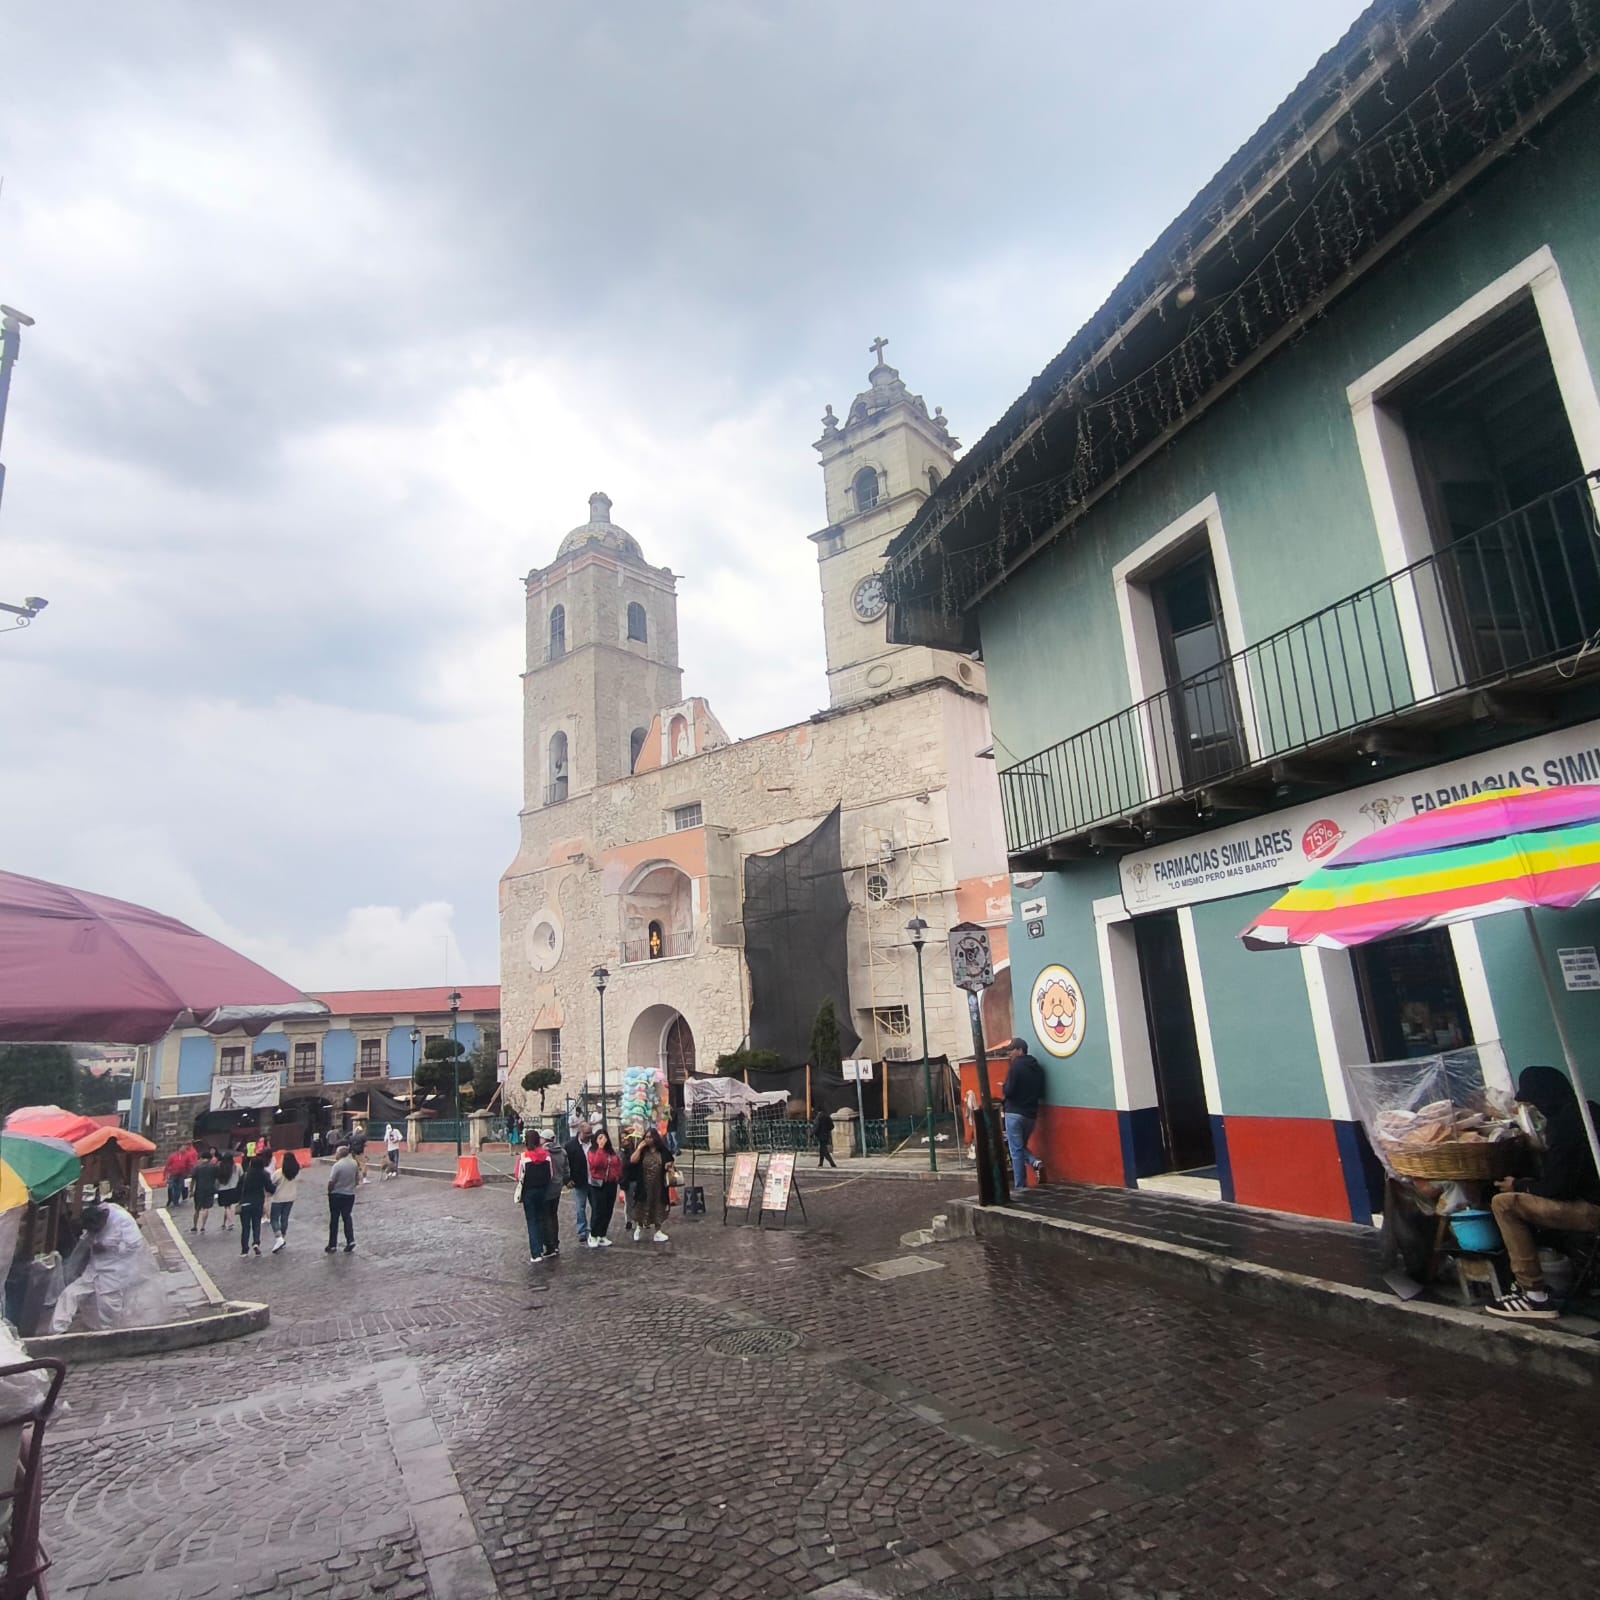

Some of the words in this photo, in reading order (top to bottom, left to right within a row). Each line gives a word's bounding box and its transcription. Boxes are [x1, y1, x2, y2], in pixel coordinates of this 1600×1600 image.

[1306, 824, 1333, 850] 75%
[1153, 848, 1219, 882] FARMACIAS
[1222, 829, 1293, 866] SIMILARES
[1181, 875, 1204, 887] MISMO
[1205, 870, 1225, 883] PERO
